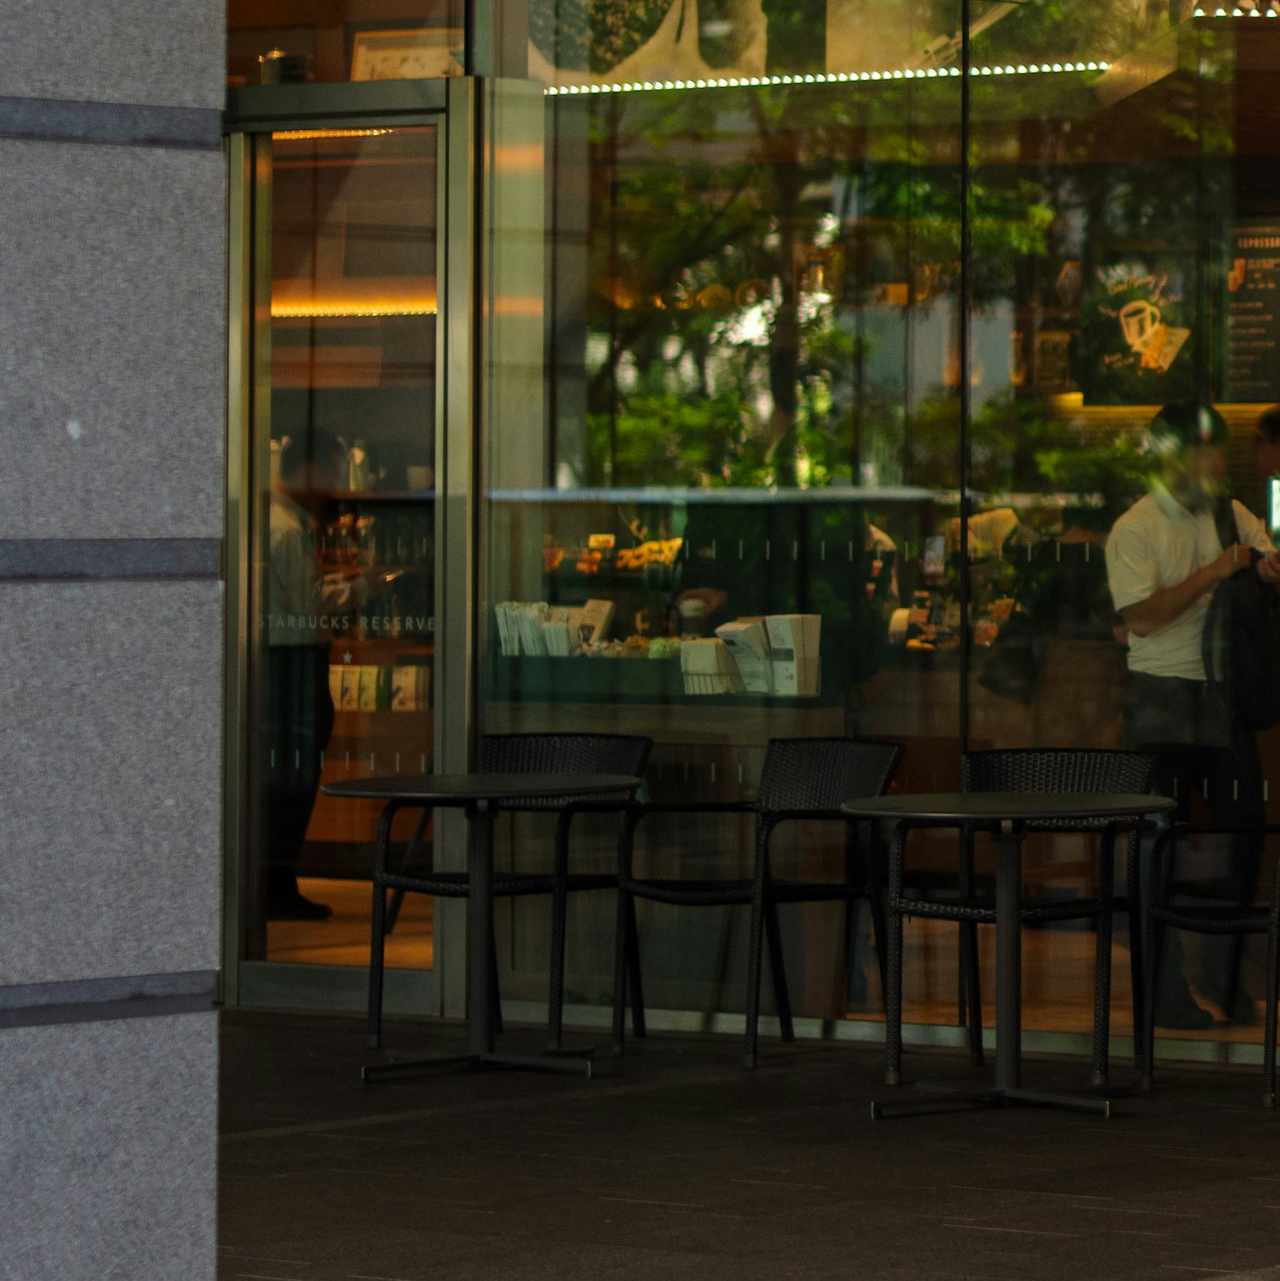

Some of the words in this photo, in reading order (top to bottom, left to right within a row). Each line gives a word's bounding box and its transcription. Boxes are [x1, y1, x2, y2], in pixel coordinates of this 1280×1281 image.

[1238, 237, 1280, 248] ESPRESSO
[259, 614, 350, 631] STARBUCKS
[358, 615, 435, 632] RESERVE
